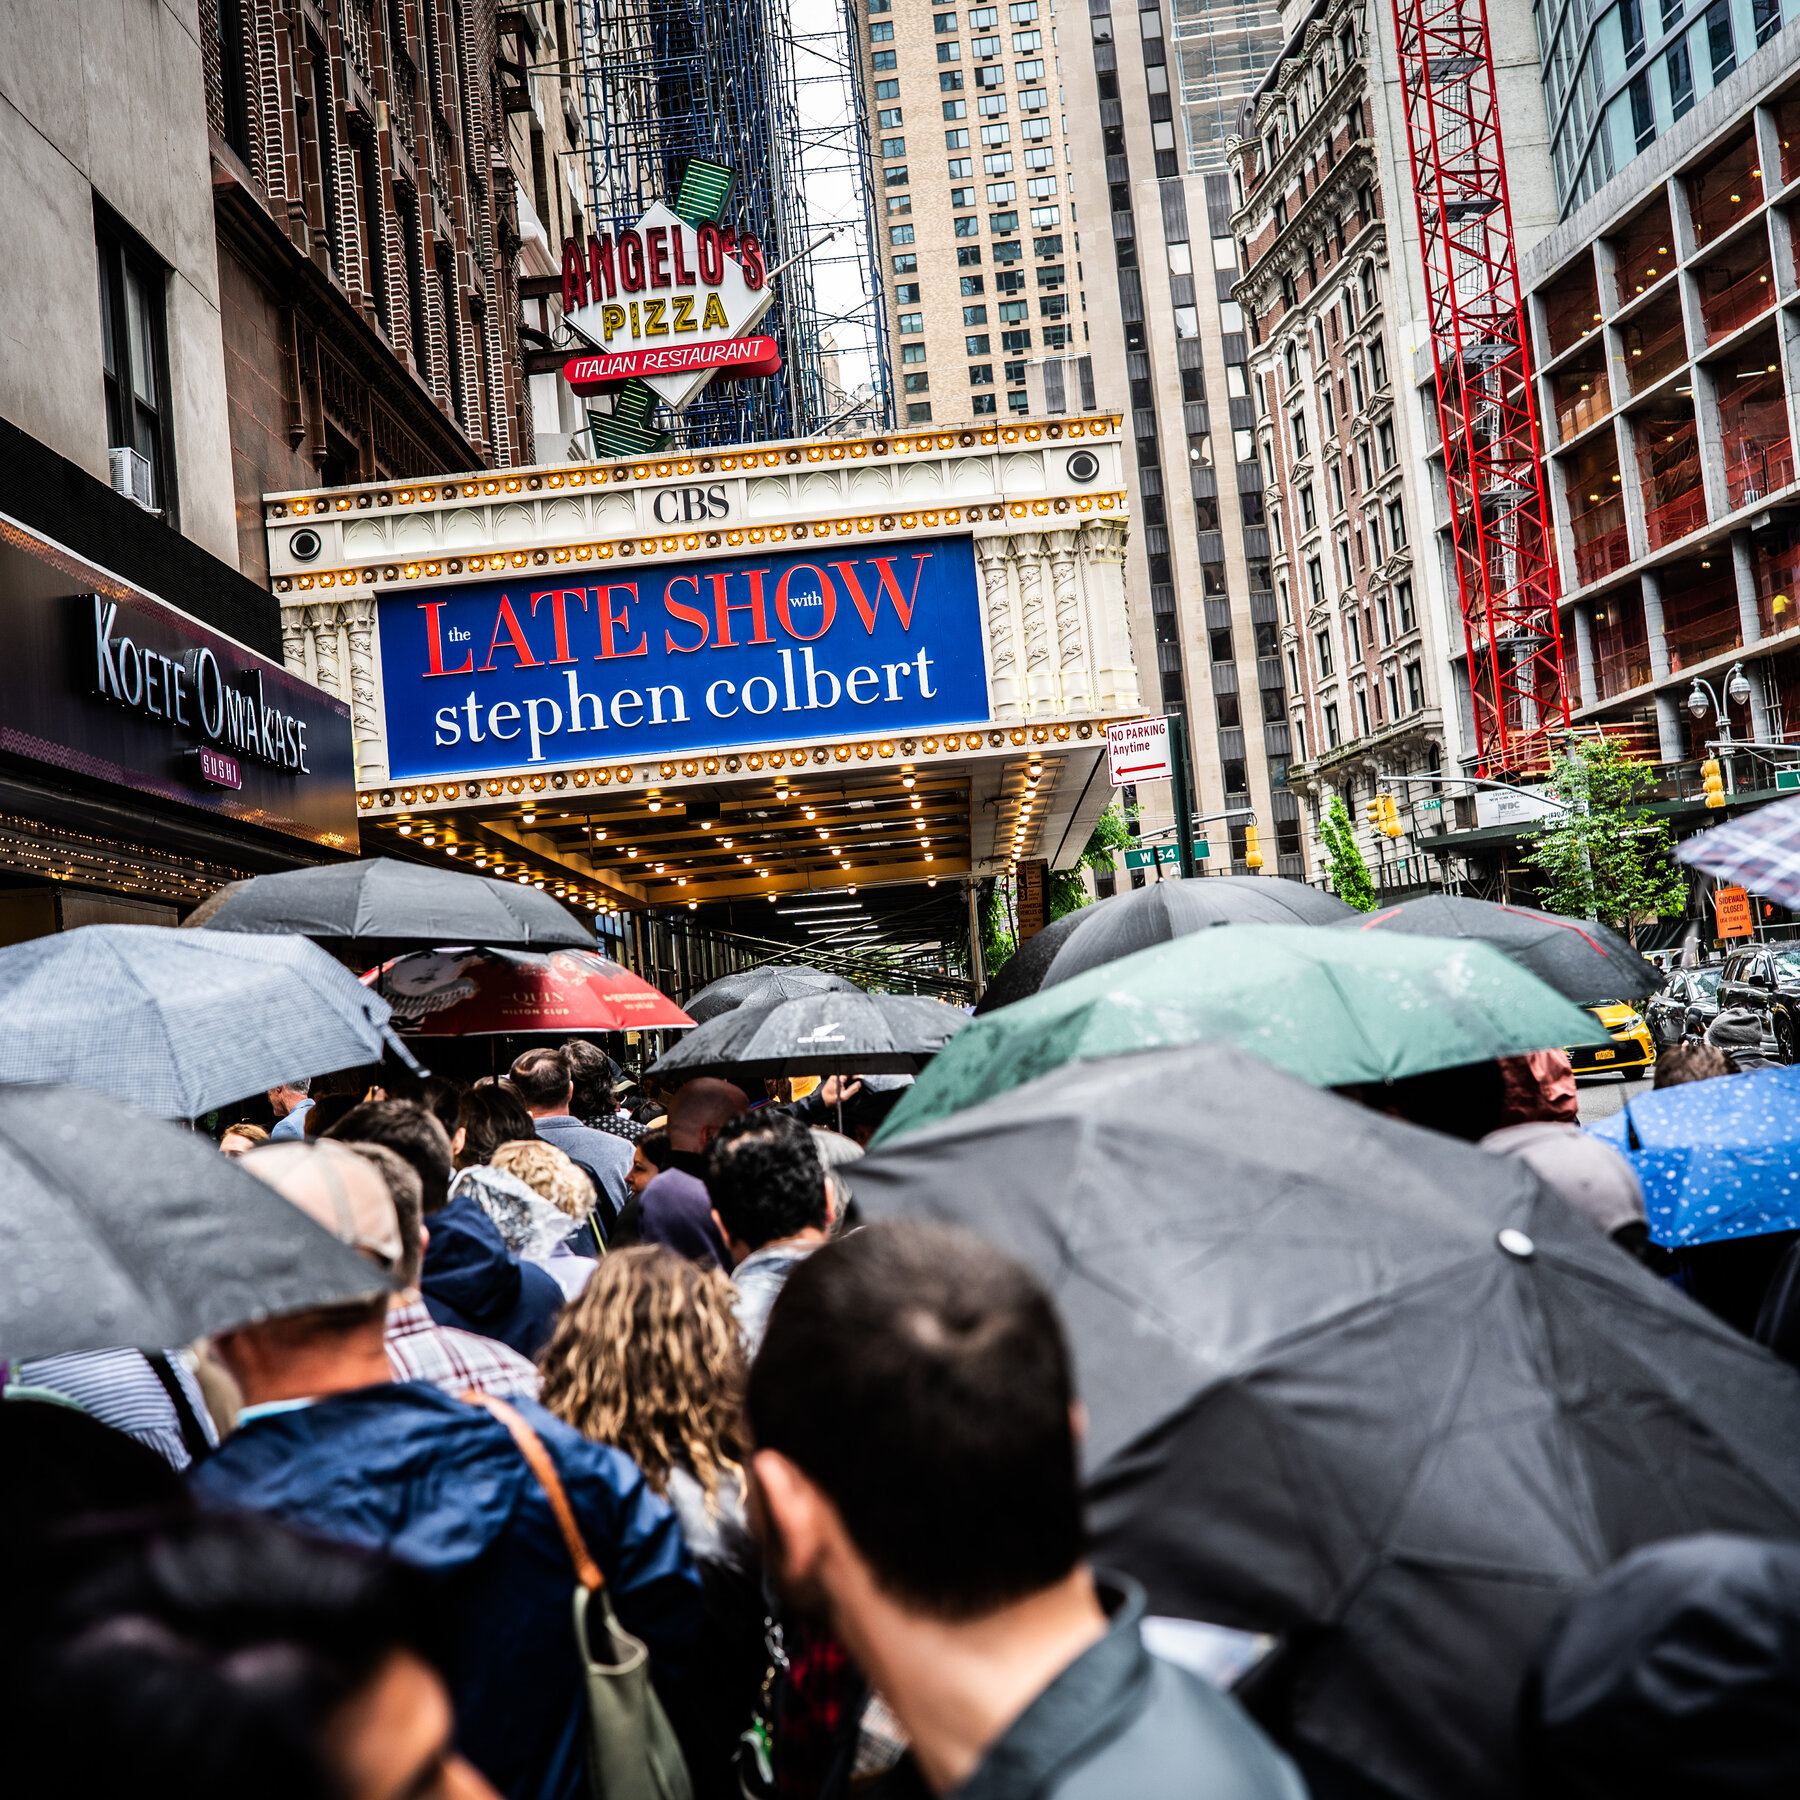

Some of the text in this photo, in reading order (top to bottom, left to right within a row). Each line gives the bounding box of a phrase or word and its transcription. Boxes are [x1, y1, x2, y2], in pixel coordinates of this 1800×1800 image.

[562, 220, 766, 314] ANGELO'S
[602, 293, 729, 340] PIZZA
[575, 340, 763, 378] ITALIAN RESTAURANT
[653, 484, 730, 525] CBS
[789, 591, 822, 608] with
[417, 552, 934, 677] LATE SHOW
[448, 626, 471, 643] the
[94, 593, 190, 727] KOETE
[435, 647, 937, 762] stephen colbert
[1111, 723, 1166, 742] NO PARKING
[1113, 741, 1150, 757] Anytime
[203, 754, 237, 783] SUSHI
[1498, 801, 1520, 811] WBC
[1140, 848, 1176, 864] W 54
[1020, 889, 1026, 900] 3
[1718, 894, 1746, 905] SIDEWALK
[1723, 904, 1744, 914] CLOSED
[513, 991, 565, 1006] QUIN
[502, 1008, 570, 1016] HILTON CLUB
